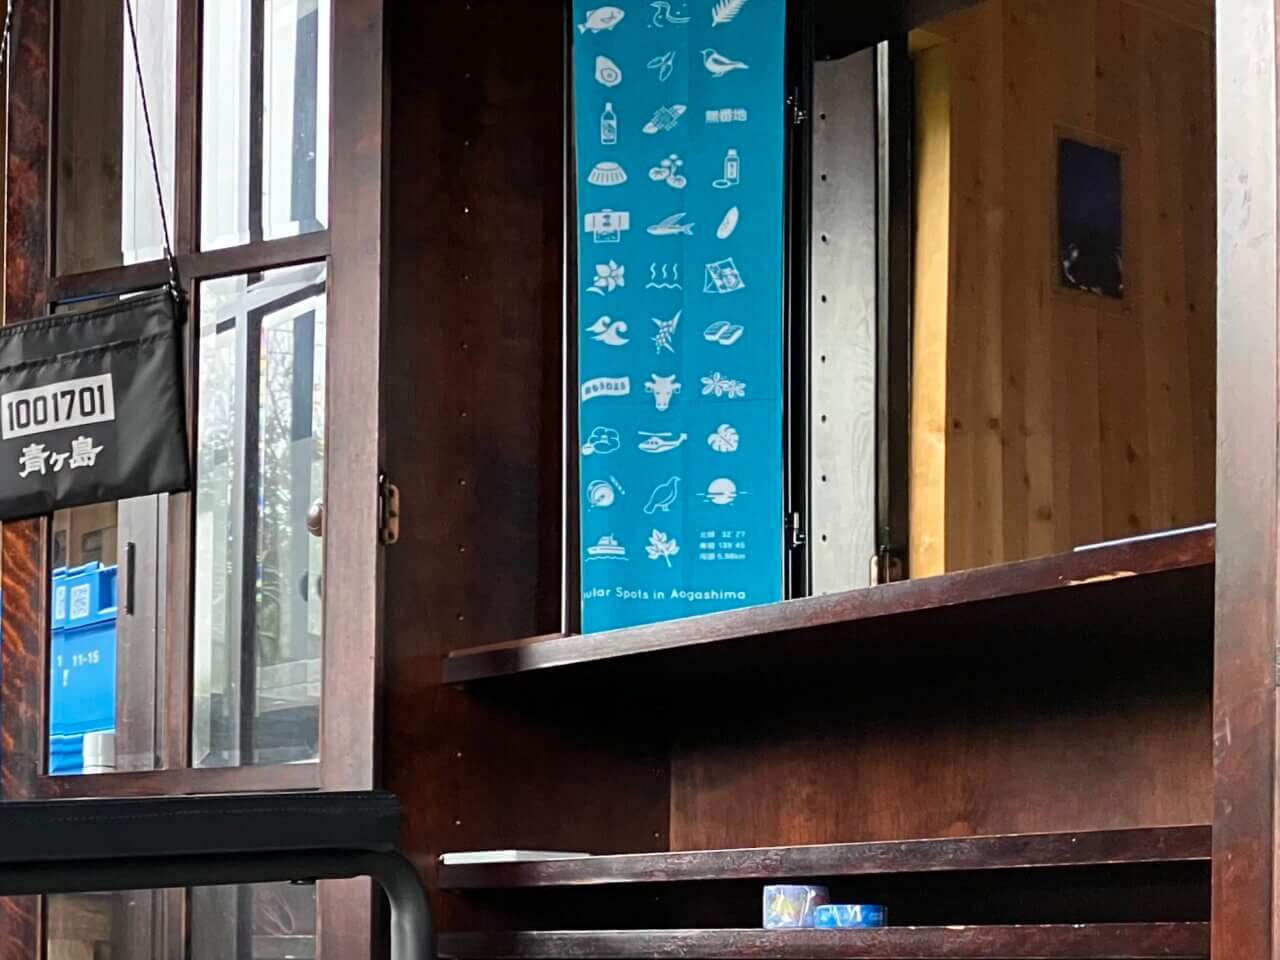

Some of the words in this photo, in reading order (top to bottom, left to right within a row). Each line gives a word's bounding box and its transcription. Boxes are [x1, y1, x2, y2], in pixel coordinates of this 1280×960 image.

[8, 384, 106, 431] 1001701
[583, 587, 611, 599] ular
[616, 587, 649, 600] Spots
[653, 589, 665, 600] in
[670, 588, 746, 601] Aogashima
